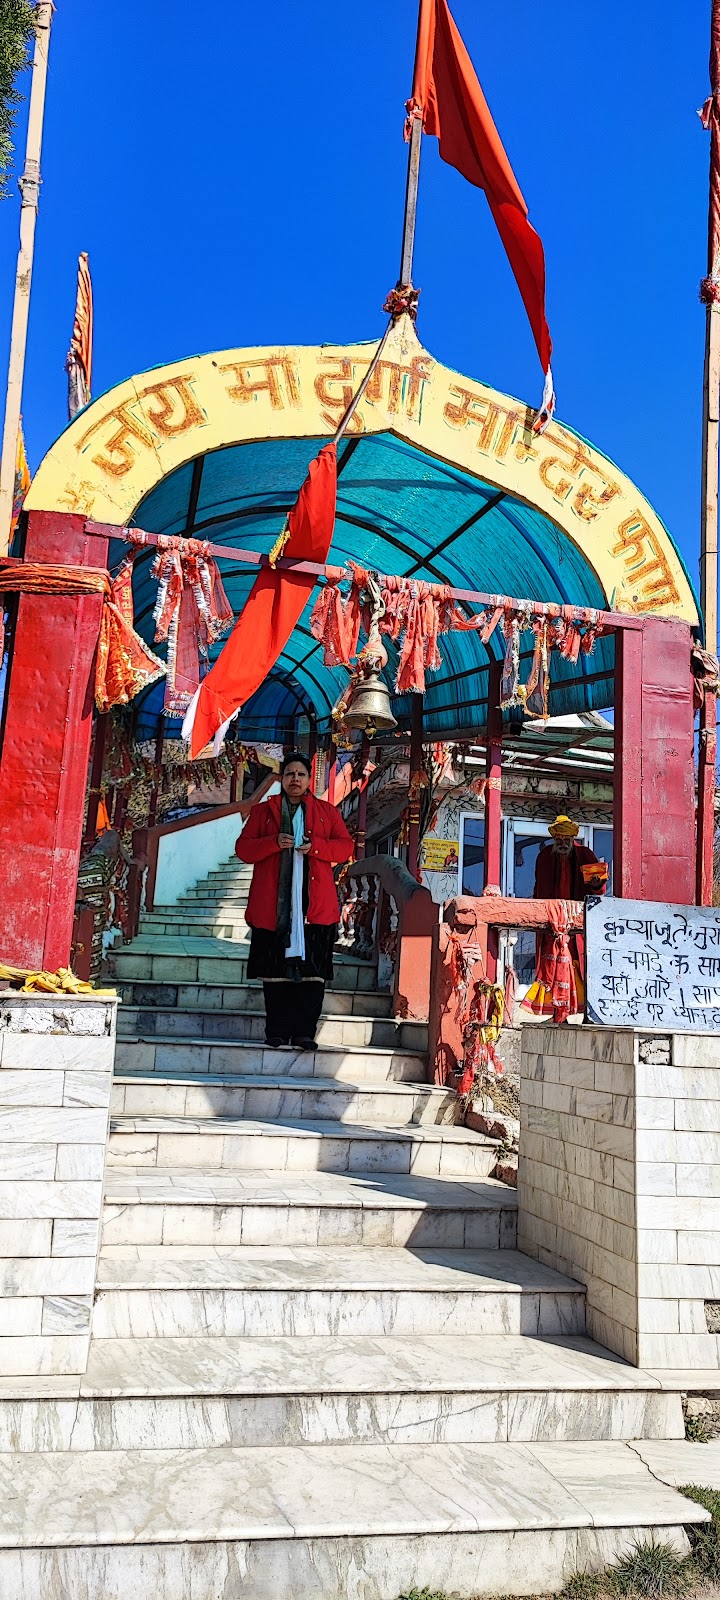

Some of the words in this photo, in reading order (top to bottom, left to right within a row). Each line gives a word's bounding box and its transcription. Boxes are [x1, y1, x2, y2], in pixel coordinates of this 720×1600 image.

[75, 373, 209, 479] जय
[314, 355, 432, 434] दुर्गा
[646, 1002, 668, 1021] पर
